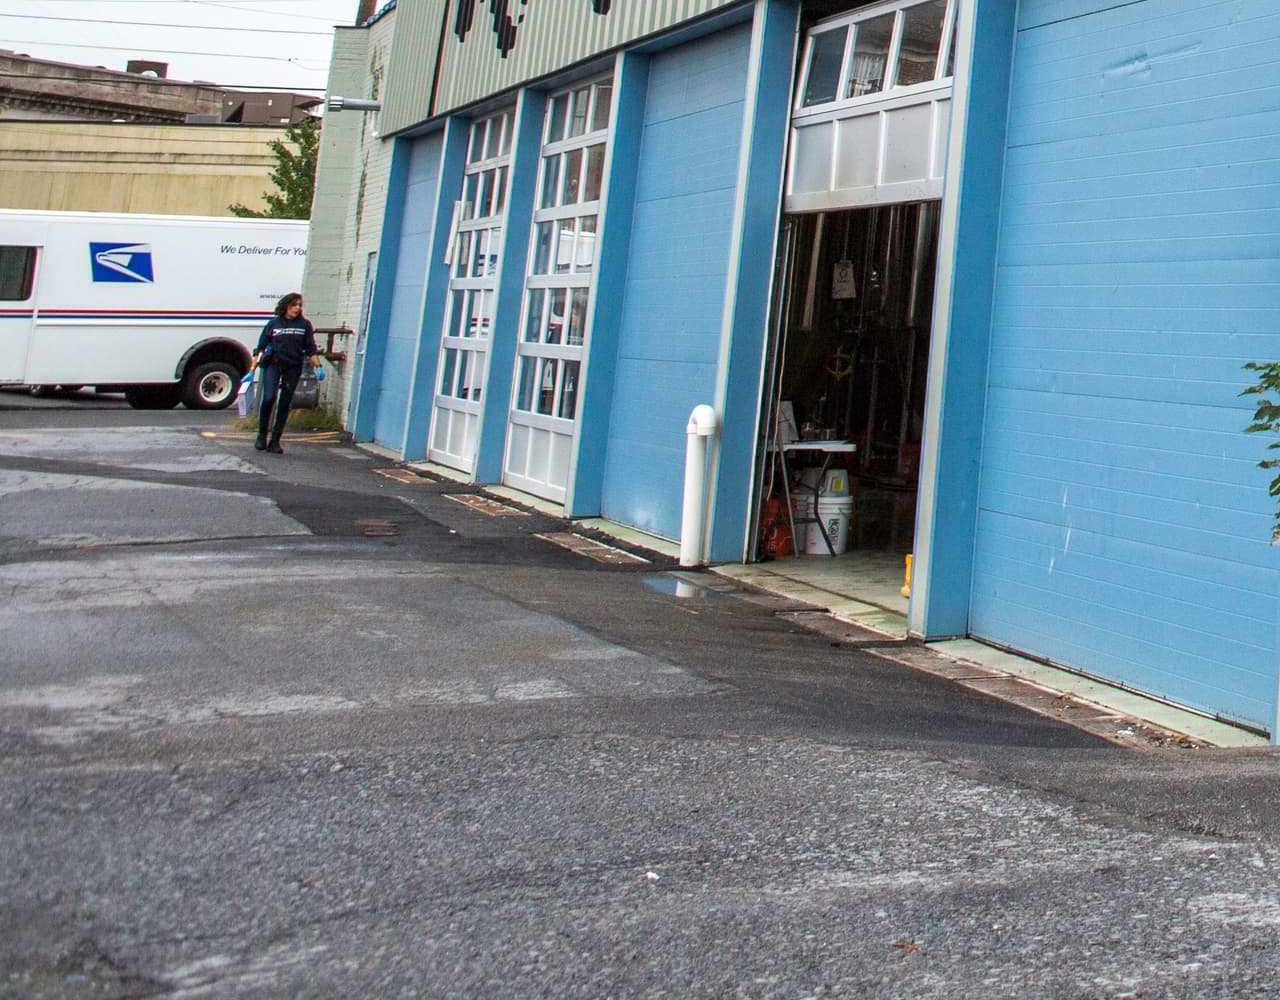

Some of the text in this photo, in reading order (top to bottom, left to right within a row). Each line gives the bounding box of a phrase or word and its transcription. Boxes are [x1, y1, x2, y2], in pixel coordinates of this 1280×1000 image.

[220, 245, 237, 254] We
[238, 245, 273, 255] Deliver
[274, 246, 291, 256] For
